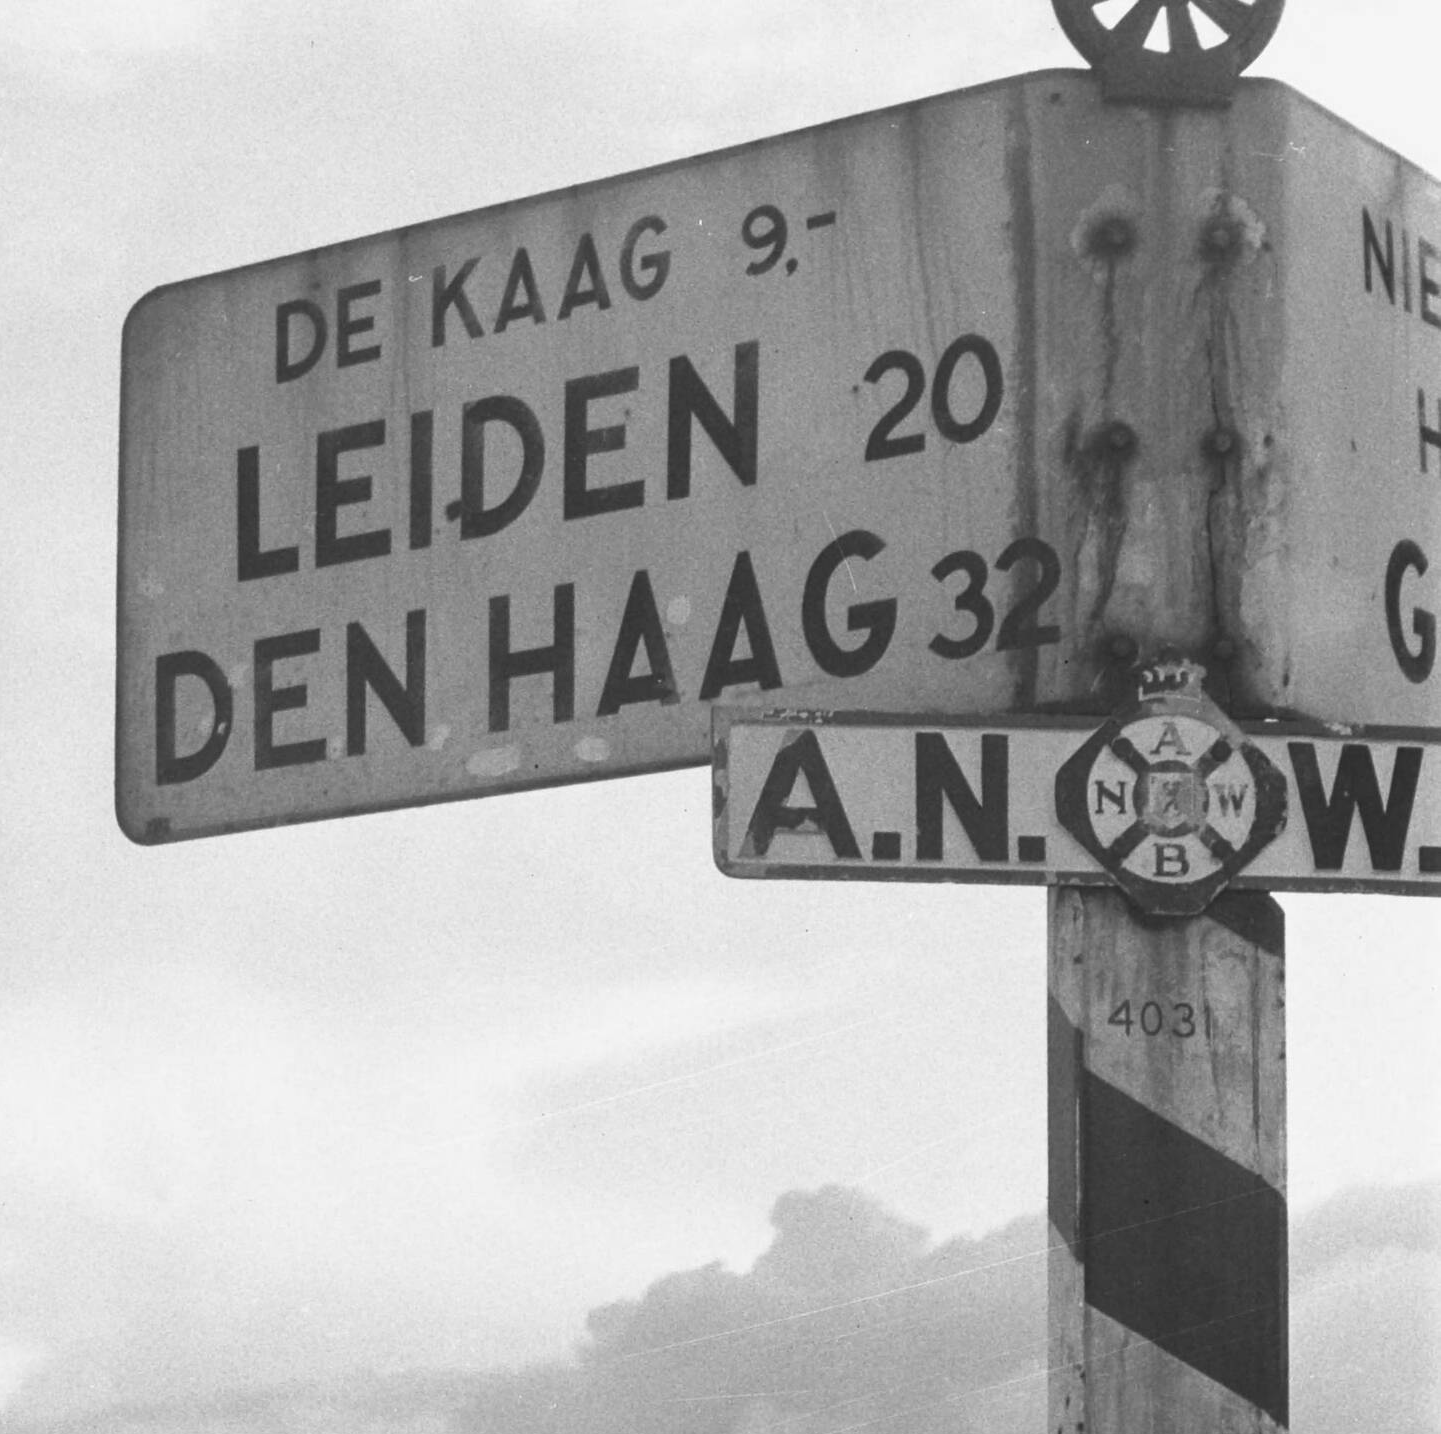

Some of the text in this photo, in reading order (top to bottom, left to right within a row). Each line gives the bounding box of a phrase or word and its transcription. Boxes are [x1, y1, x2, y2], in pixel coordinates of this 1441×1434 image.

[276, 279, 382, 384] DE
[431, 215, 672, 348] KAAG
[1361, 205, 1441, 329] NIE
[236, 334, 1004, 582] LEIDEN 20
[156, 530, 1062, 787] DEN HAAG 32
[1384, 538, 1436, 684] G
[736, 729, 1047, 863] A.N.
